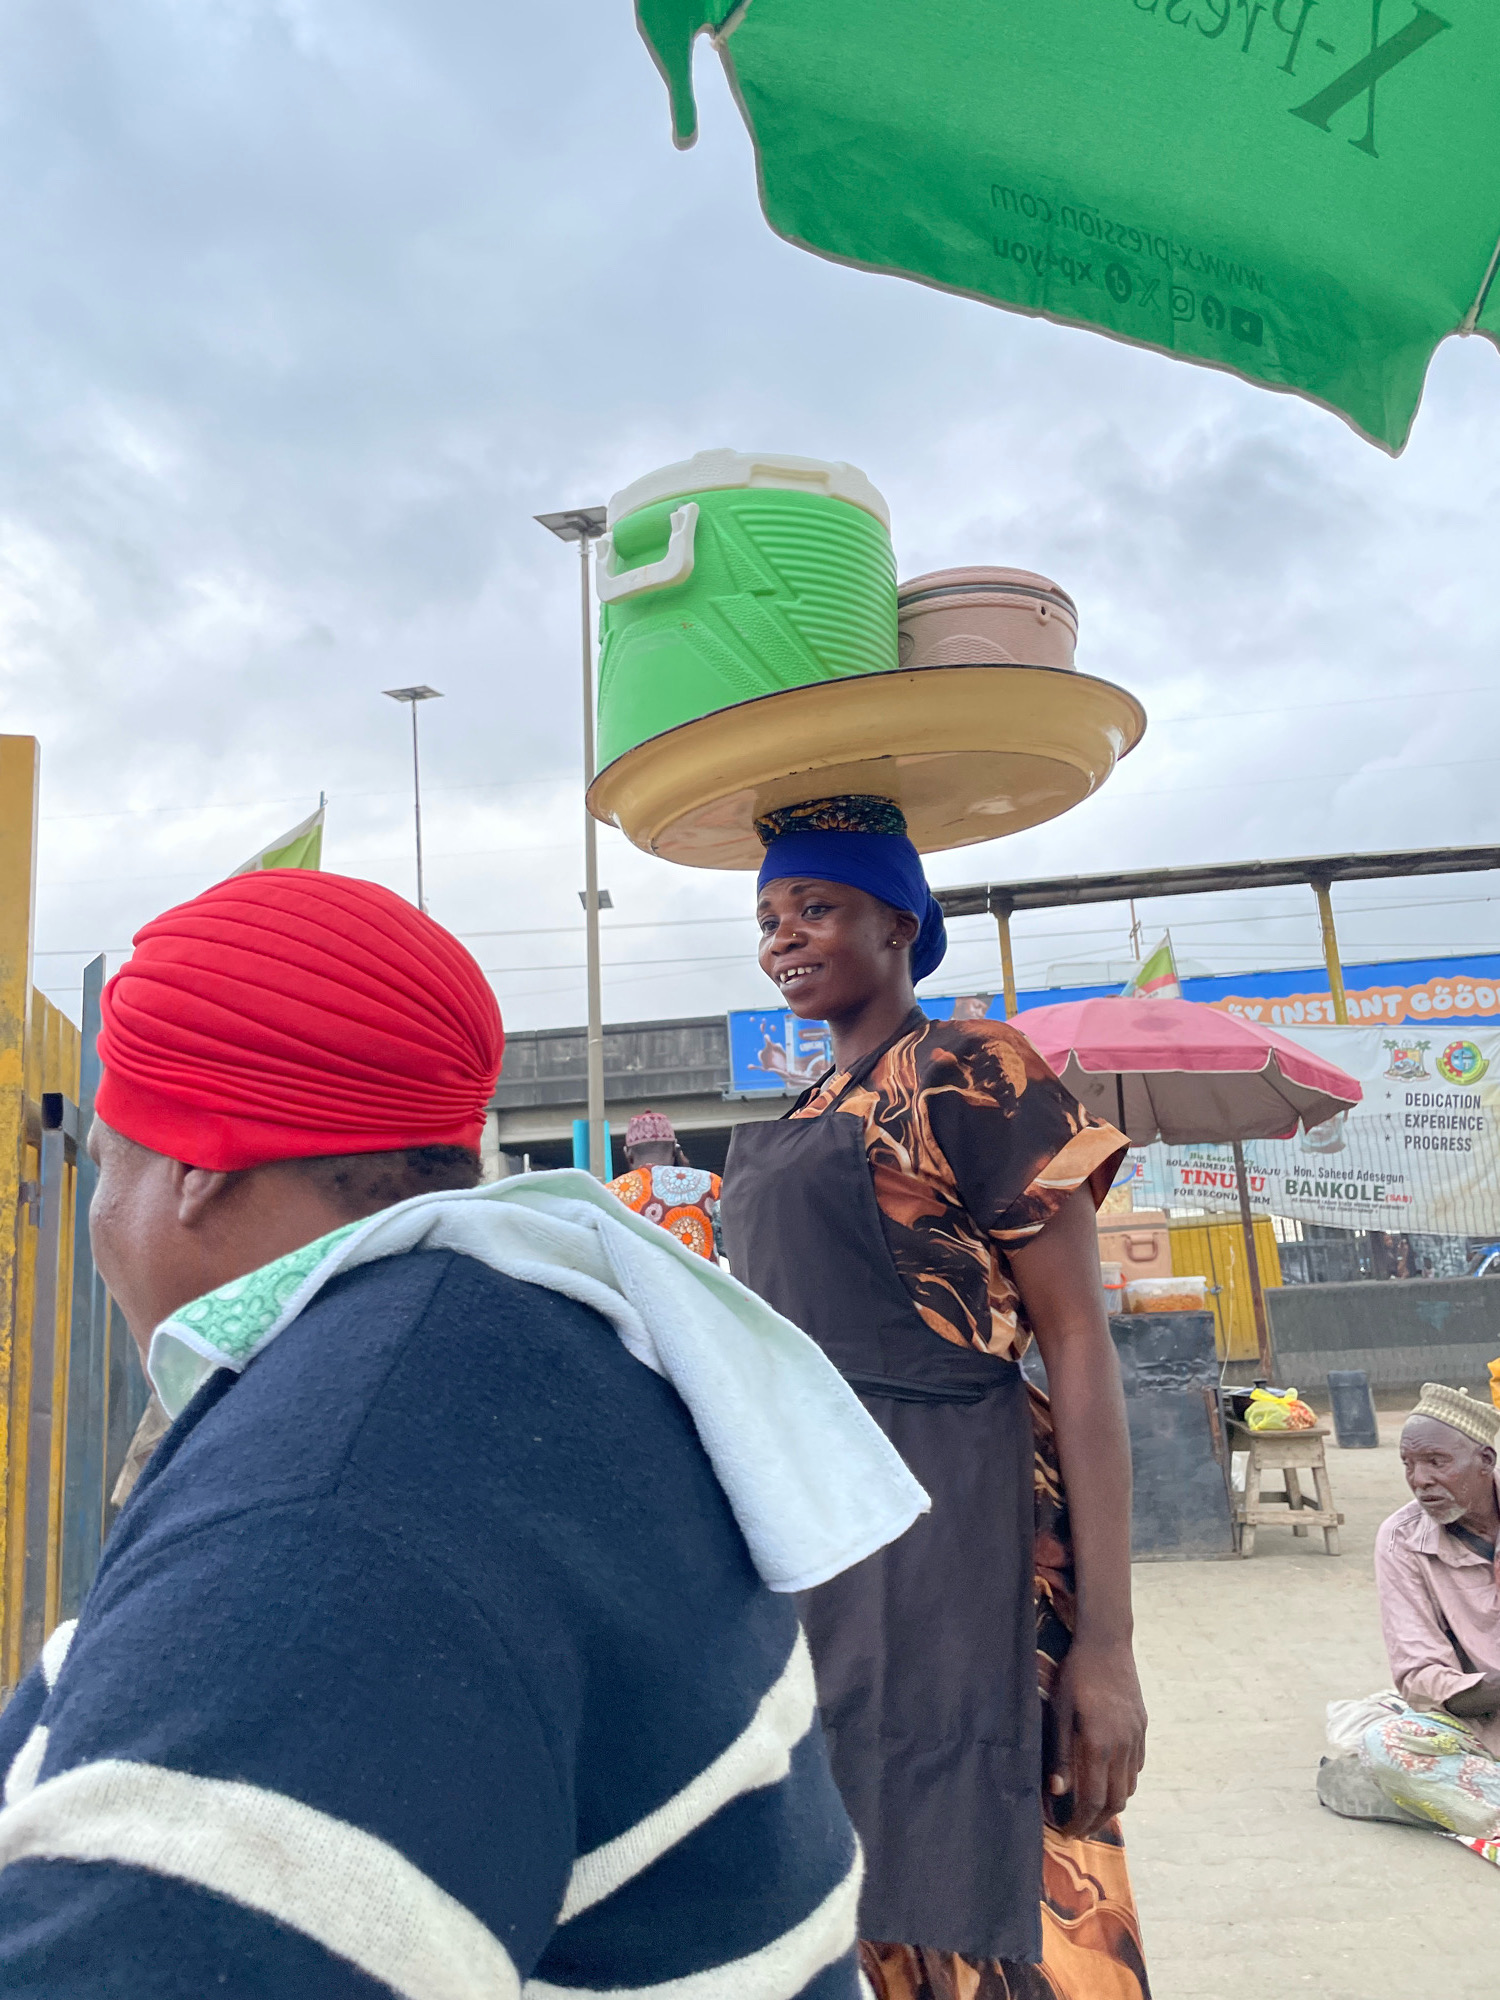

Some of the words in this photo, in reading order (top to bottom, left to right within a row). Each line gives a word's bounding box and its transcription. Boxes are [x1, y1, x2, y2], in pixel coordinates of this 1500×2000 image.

[1271, 994, 1402, 1025] INSTANT
[1410, 983, 1500, 1013] GÖÖD
[1405, 1092, 1481, 1109] DEDICATION
[1404, 1114, 1483, 1131] EXPERIENCE
[1404, 1135, 1472, 1152] PROGRESS
[1166, 1159, 1189, 1167] BOLA
[1193, 1160, 1226, 1171] AHMED
[1229, 1165, 1280, 1175] AIWAJU
[1294, 1165, 1315, 1178] Hon.
[1318, 1167, 1354, 1180] Saheed
[1356, 1170, 1404, 1184] Adesegun
[1180, 1169, 1266, 1192] TINUU
[1174, 1188, 1194, 1196] FOR
[1197, 1189, 1238, 1201] SECOND
[1285, 1179, 1385, 1202] BANKOLE
